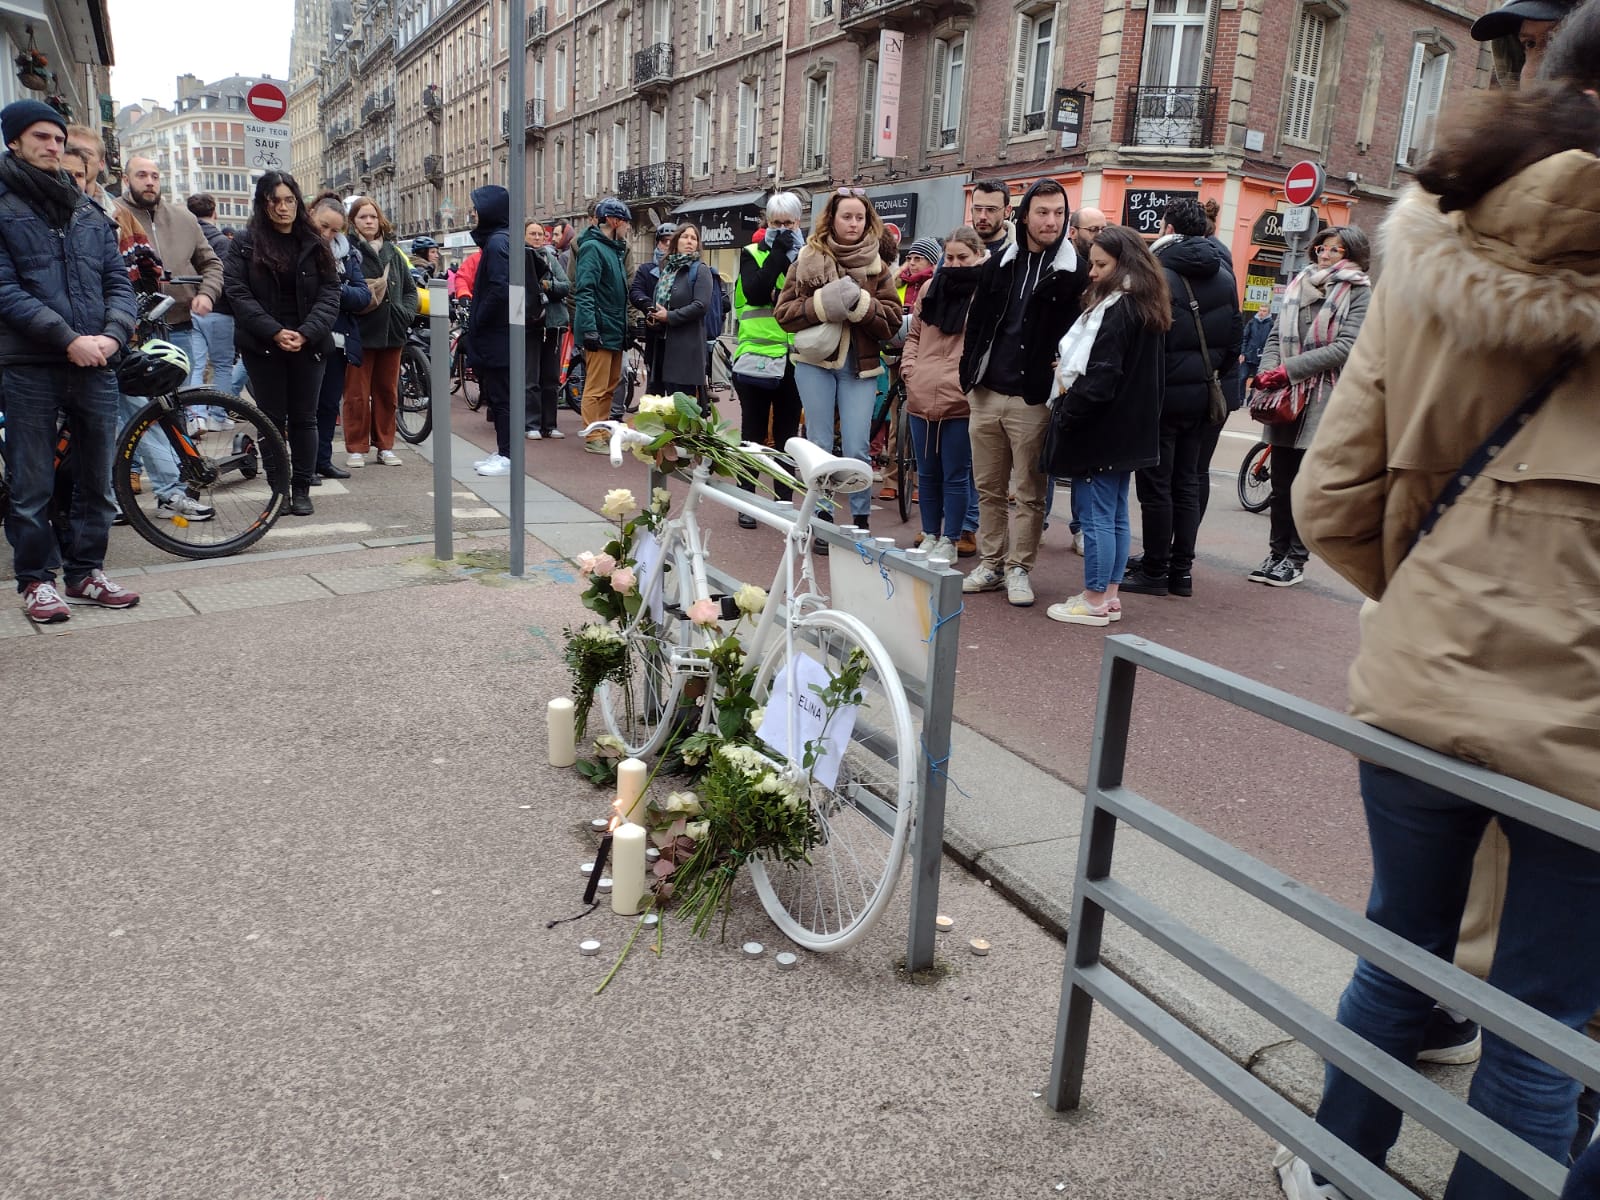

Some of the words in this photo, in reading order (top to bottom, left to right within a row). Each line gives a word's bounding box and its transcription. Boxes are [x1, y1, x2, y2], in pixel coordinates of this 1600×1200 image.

[246, 124, 266, 133] SAUF
[255, 138, 280, 149] SAUF
[874, 198, 908, 210] PRONAILS
[1290, 208, 1304, 216] SAUF
[1252, 276, 1275, 287] VENDRE
[1250, 289, 1269, 301] LBH
[798, 694, 821, 721] ELINA
